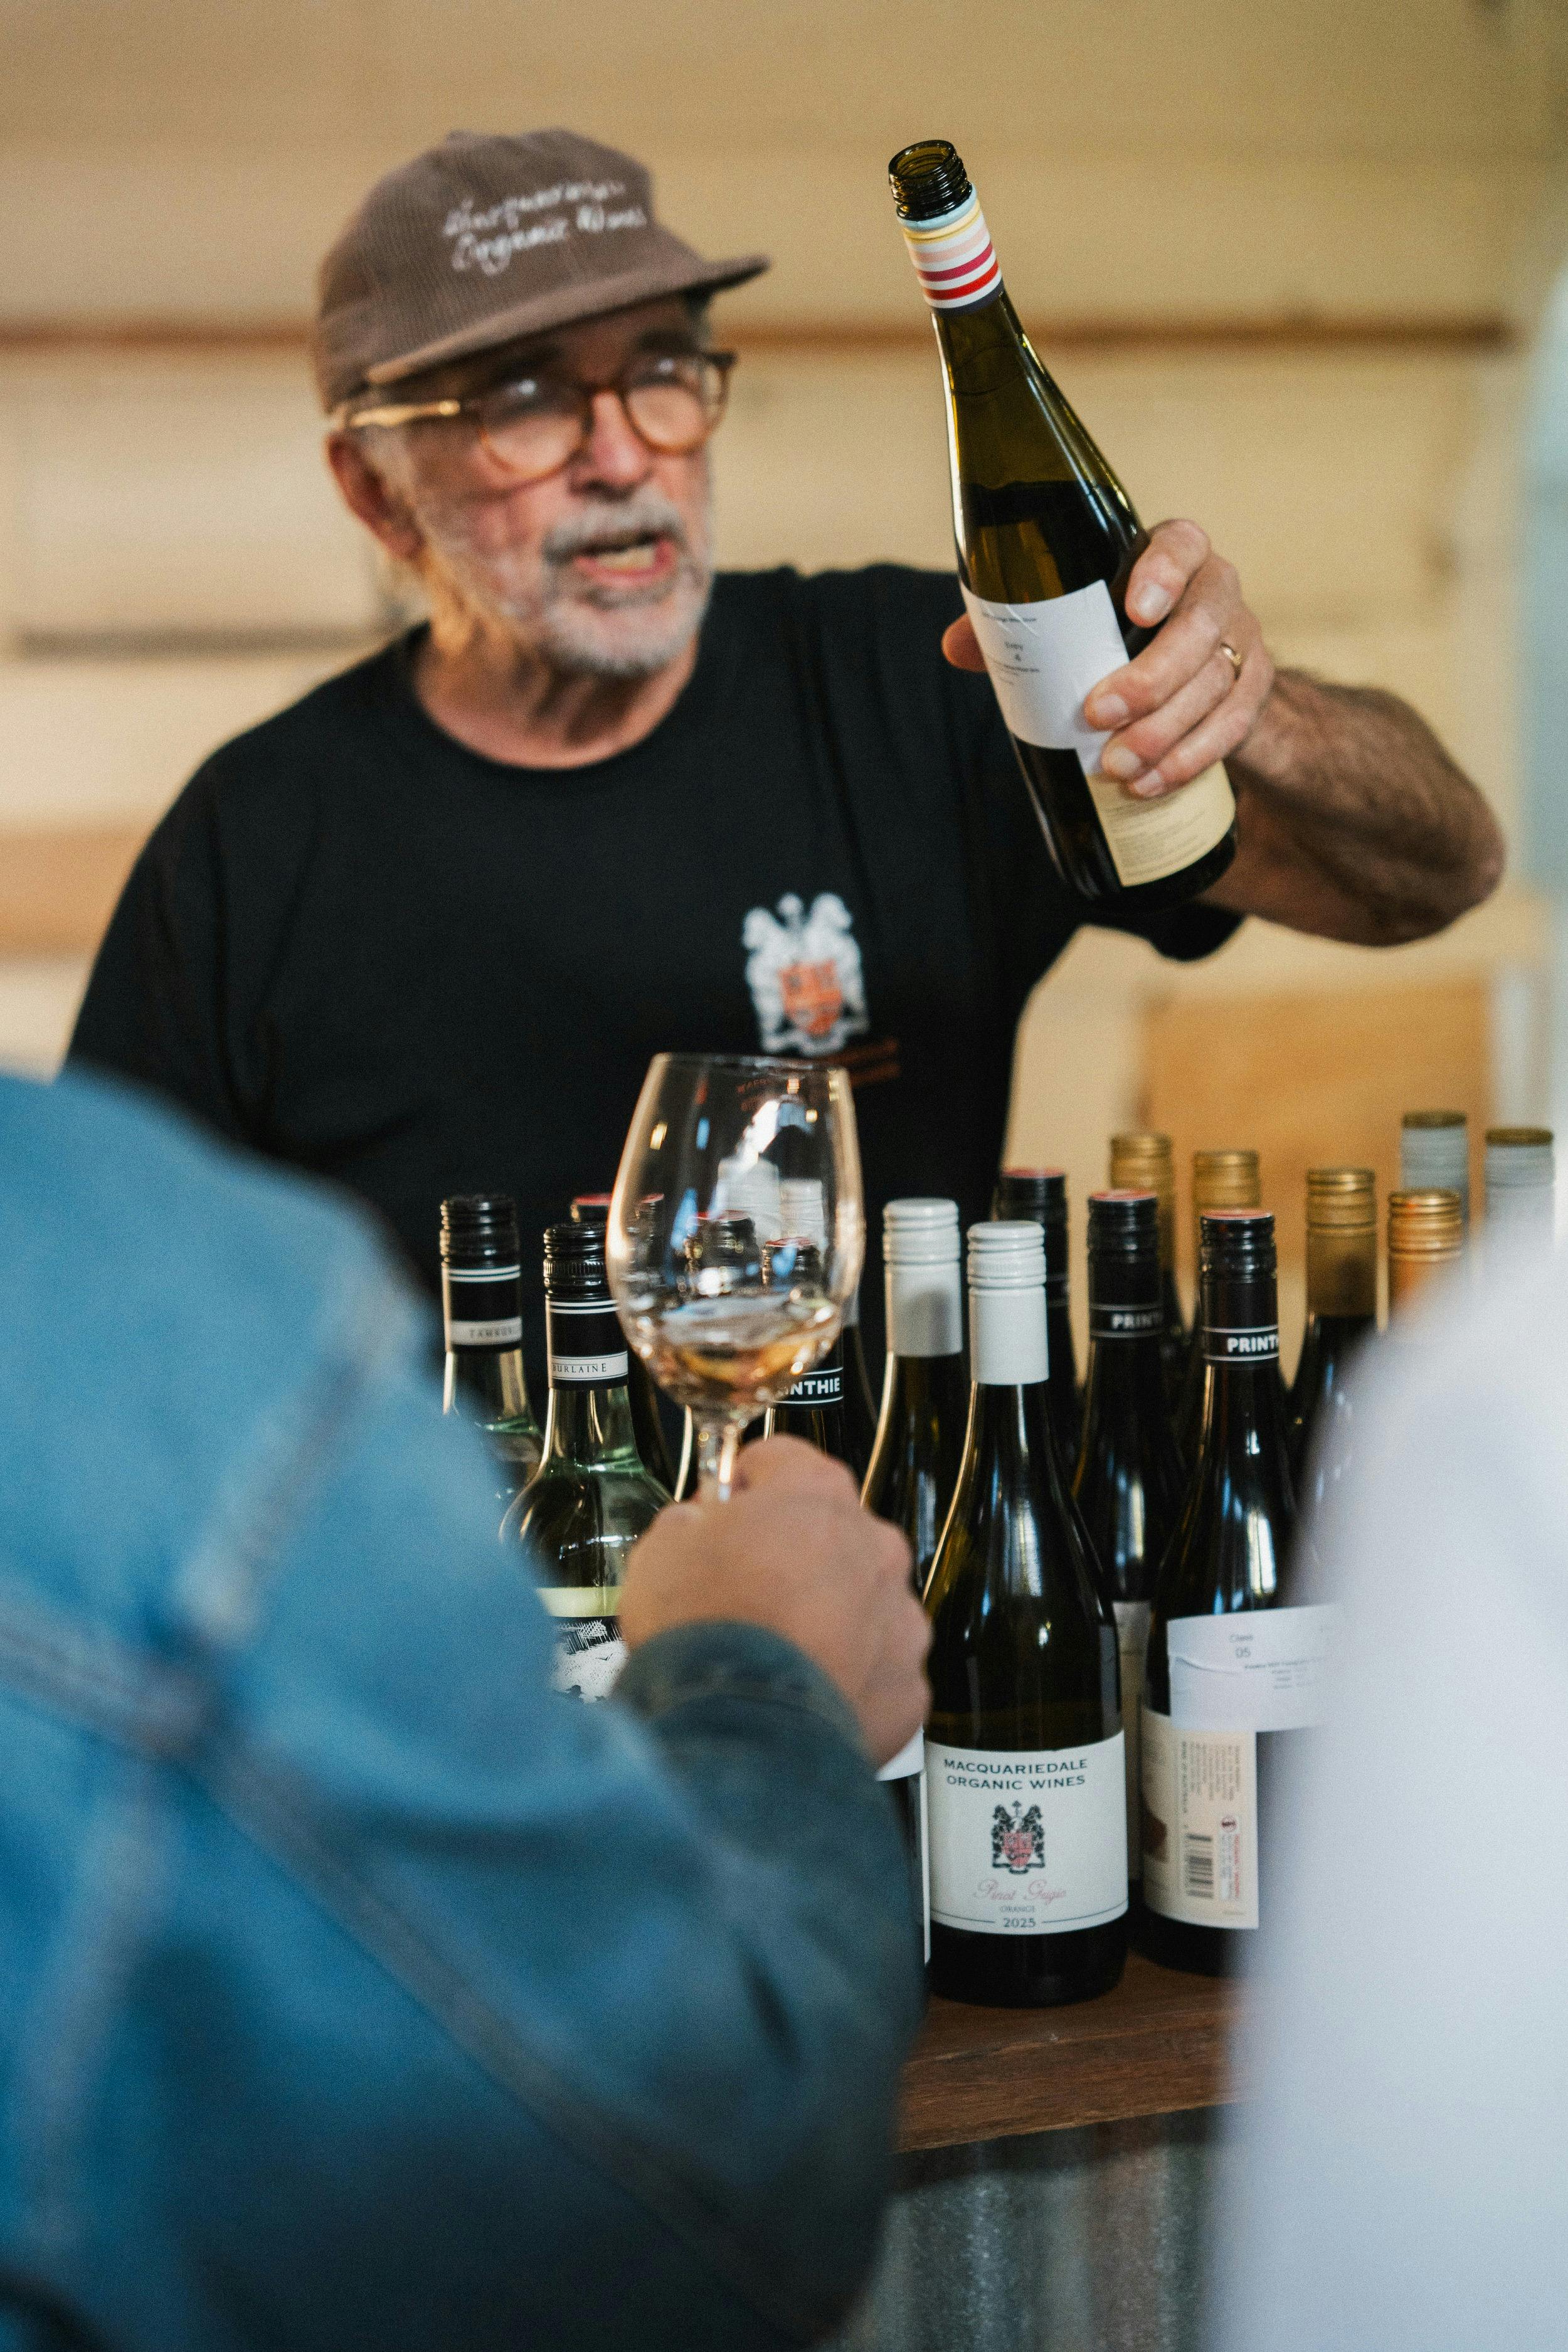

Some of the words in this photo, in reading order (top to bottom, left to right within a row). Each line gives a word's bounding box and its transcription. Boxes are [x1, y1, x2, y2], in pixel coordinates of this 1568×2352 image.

[943, 1758, 1088, 1775] MACQUARIEDALE
[946, 1775, 1023, 1790] ORGANIC
[1029, 1775, 1086, 1789] WINES
[1003, 1917, 1036, 1928] 2025
